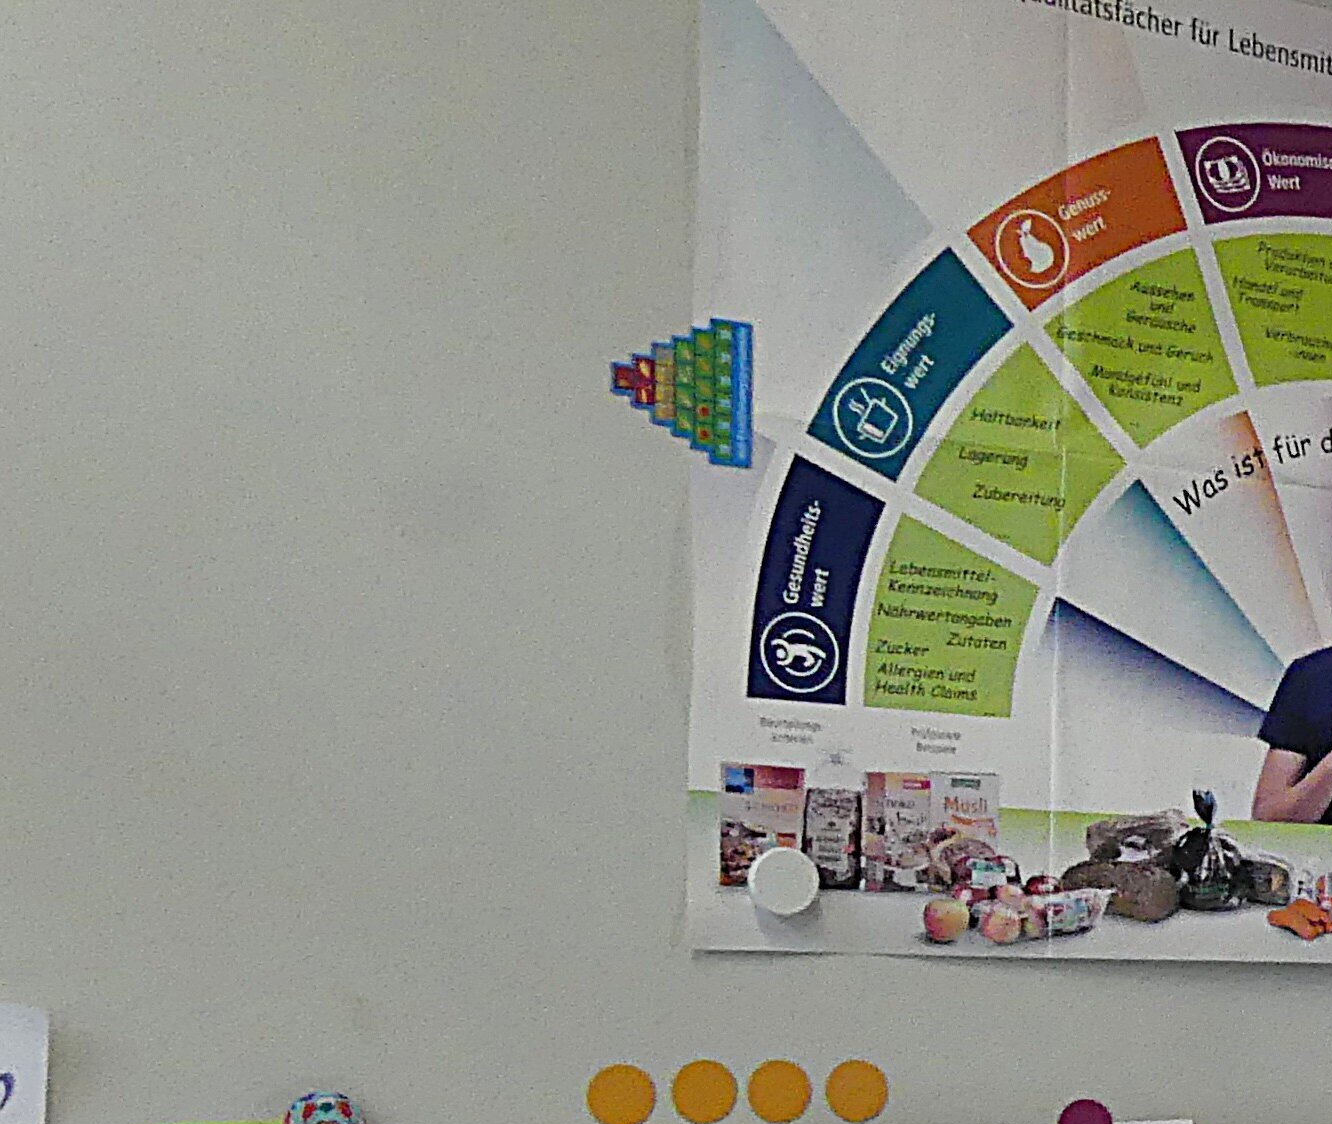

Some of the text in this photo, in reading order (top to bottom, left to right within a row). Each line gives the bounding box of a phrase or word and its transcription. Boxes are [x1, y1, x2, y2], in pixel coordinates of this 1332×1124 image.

[1021, 0, 1183, 36] tätsfächer
[1190, 17, 1220, 47] für
[1268, 174, 1300, 191] Wert
[1058, 189, 1112, 220] Genuss-
[1072, 216, 1107, 242] wert
[881, 312, 936, 376] Eignungs-
[904, 354, 935, 390] wert
[958, 447, 1029, 470] Lagerung
[1172, 468, 1229, 515] Was
[1232, 447, 1266, 480] ist
[1273, 435, 1312, 464] für
[972, 483, 1066, 512] Zubereitung
[782, 500, 823, 605] Gesundheits-
[889, 562, 996, 583] Lebensmittel-
[810, 565, 830, 608] wert
[887, 578, 999, 605] Kennzeichnung
[877, 603, 1012, 629] Nährwertangaben
[875, 638, 930, 657] Zucker
[946, 631, 1008, 651] Zutaten
[877, 661, 976, 683] Allergien und
[875, 681, 978, 701] Health Claims
